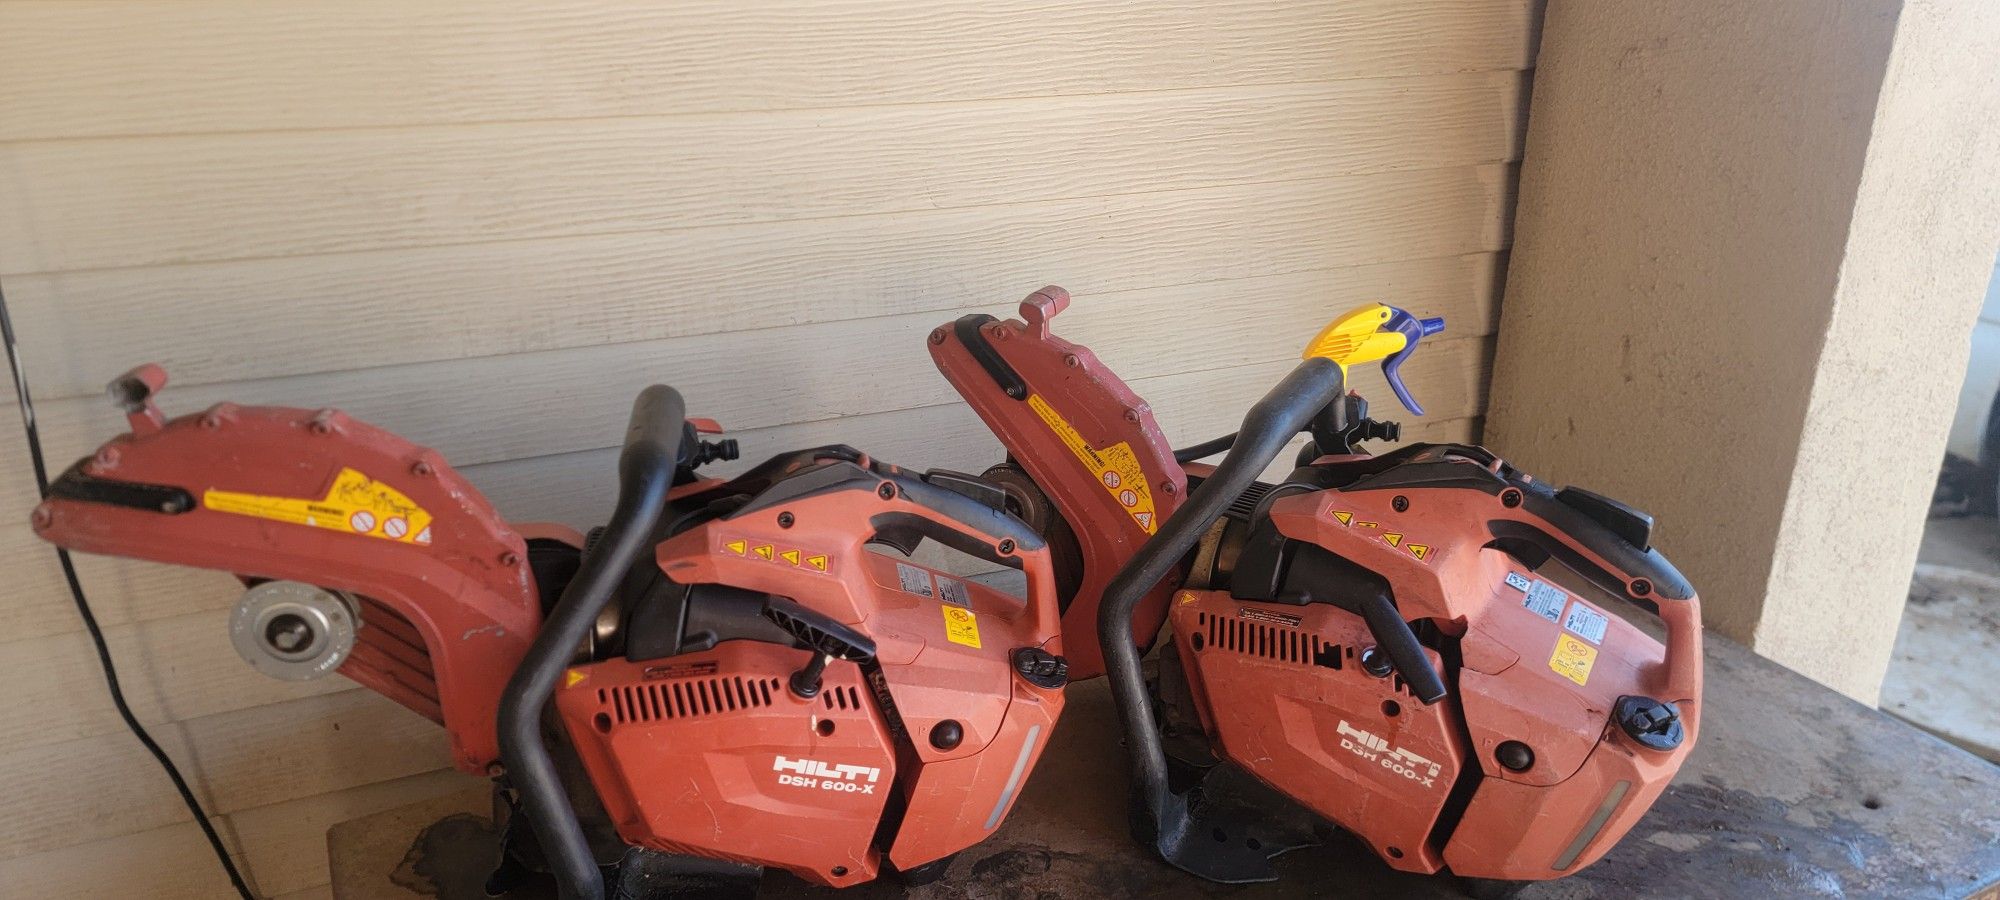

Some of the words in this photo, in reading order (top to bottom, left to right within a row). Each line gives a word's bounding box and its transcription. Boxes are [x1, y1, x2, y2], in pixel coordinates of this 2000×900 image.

[1337, 720, 1442, 777] HILTI
[773, 755, 880, 782] HILTI
[1380, 758, 1434, 788] 600-X
[778, 774, 817, 788] DSH
[821, 780, 875, 794] 600-X
